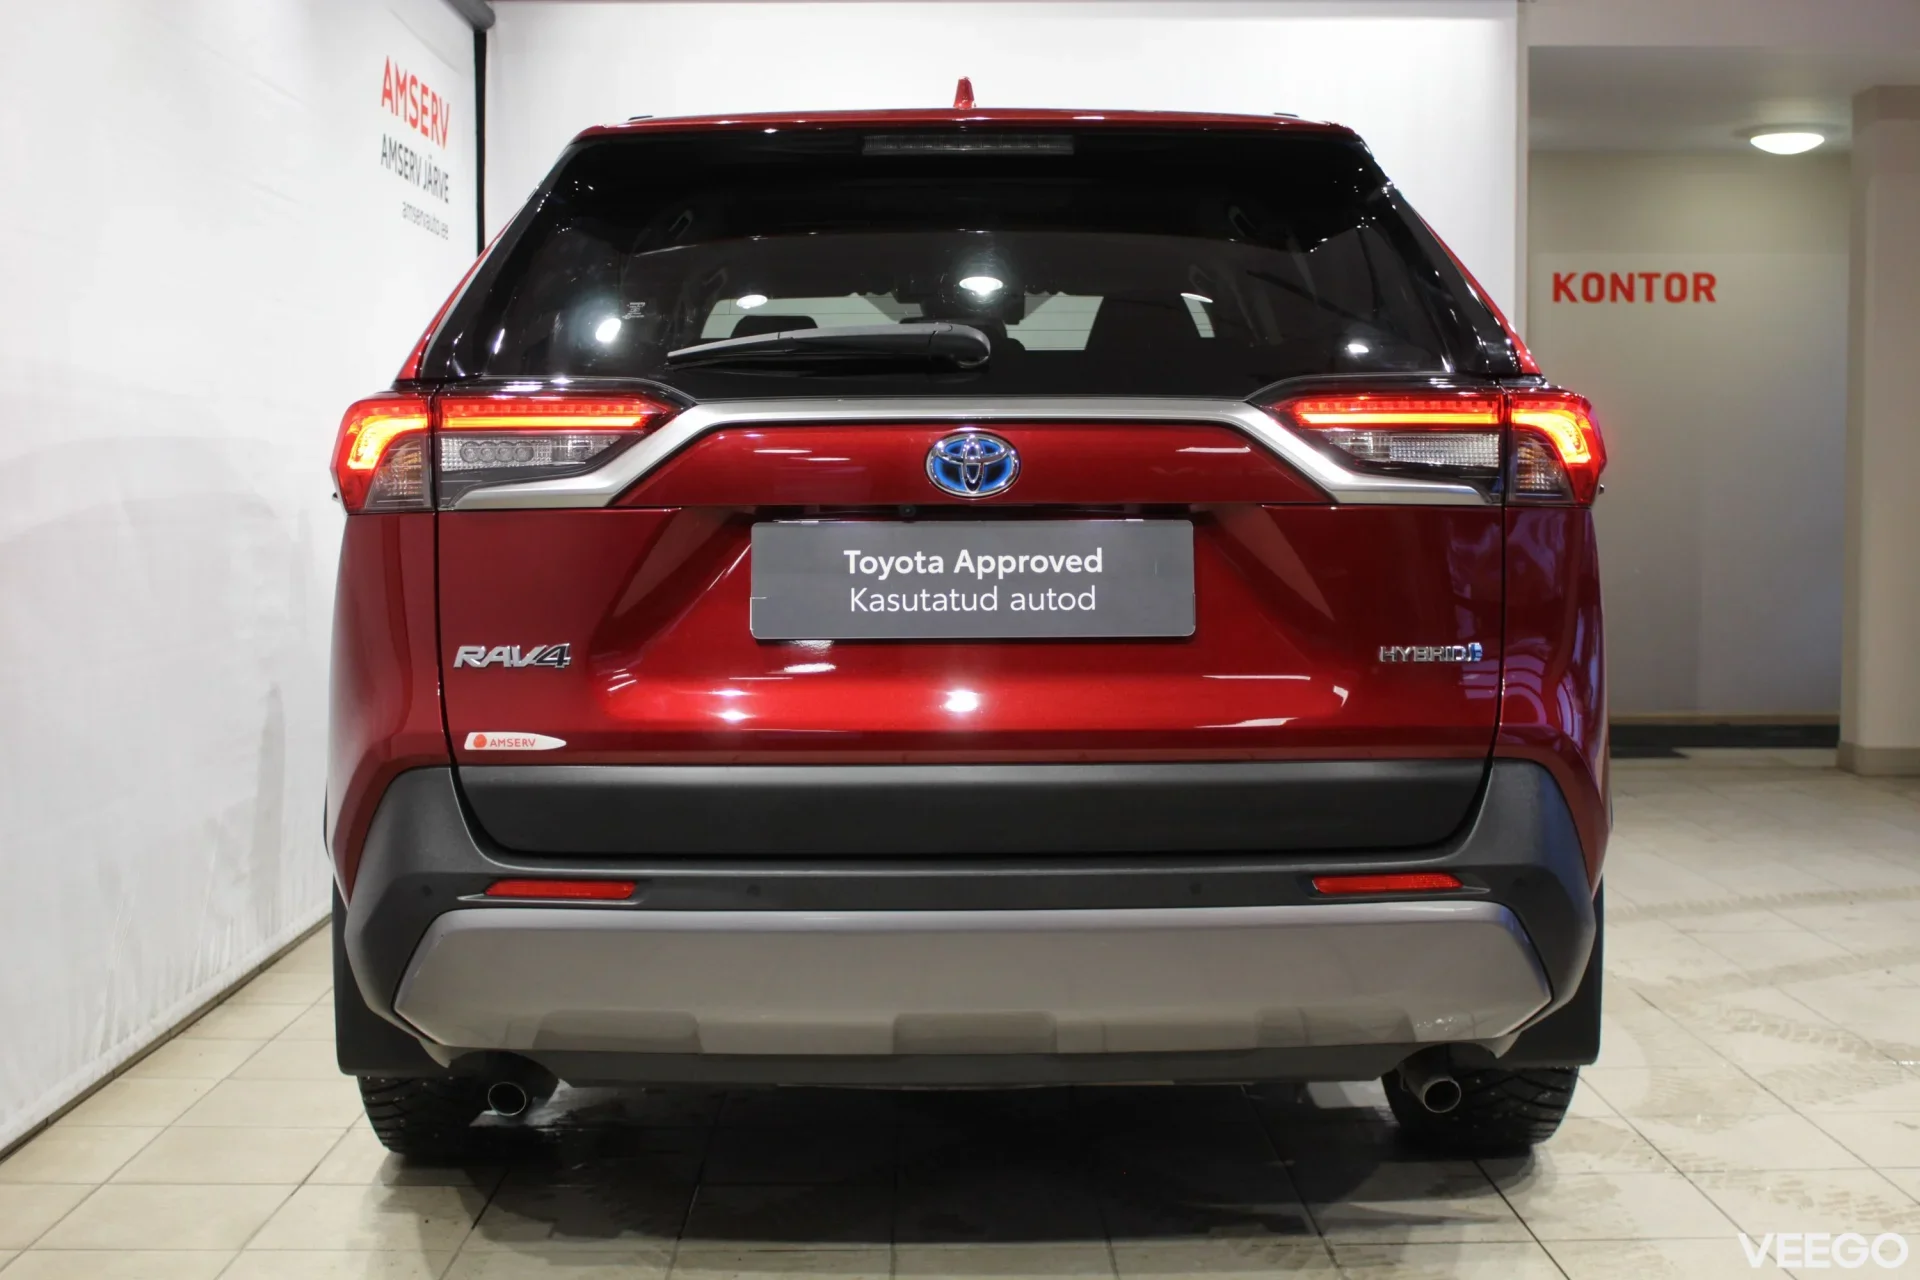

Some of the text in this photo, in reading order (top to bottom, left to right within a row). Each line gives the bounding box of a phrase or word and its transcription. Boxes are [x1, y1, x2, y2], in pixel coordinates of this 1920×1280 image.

[381, 55, 450, 150] AMSERV
[380, 133, 449, 204] AMSERV JÄRVE
[1553, 271, 1717, 303] KONTOR
[843, 547, 1103, 580] Toyota Approved
[850, 585, 1096, 612] Kasutatud autod
[453, 643, 572, 669] RAV4
[1379, 645, 1467, 662] HYBRID
[489, 738, 536, 748] AMSERV
